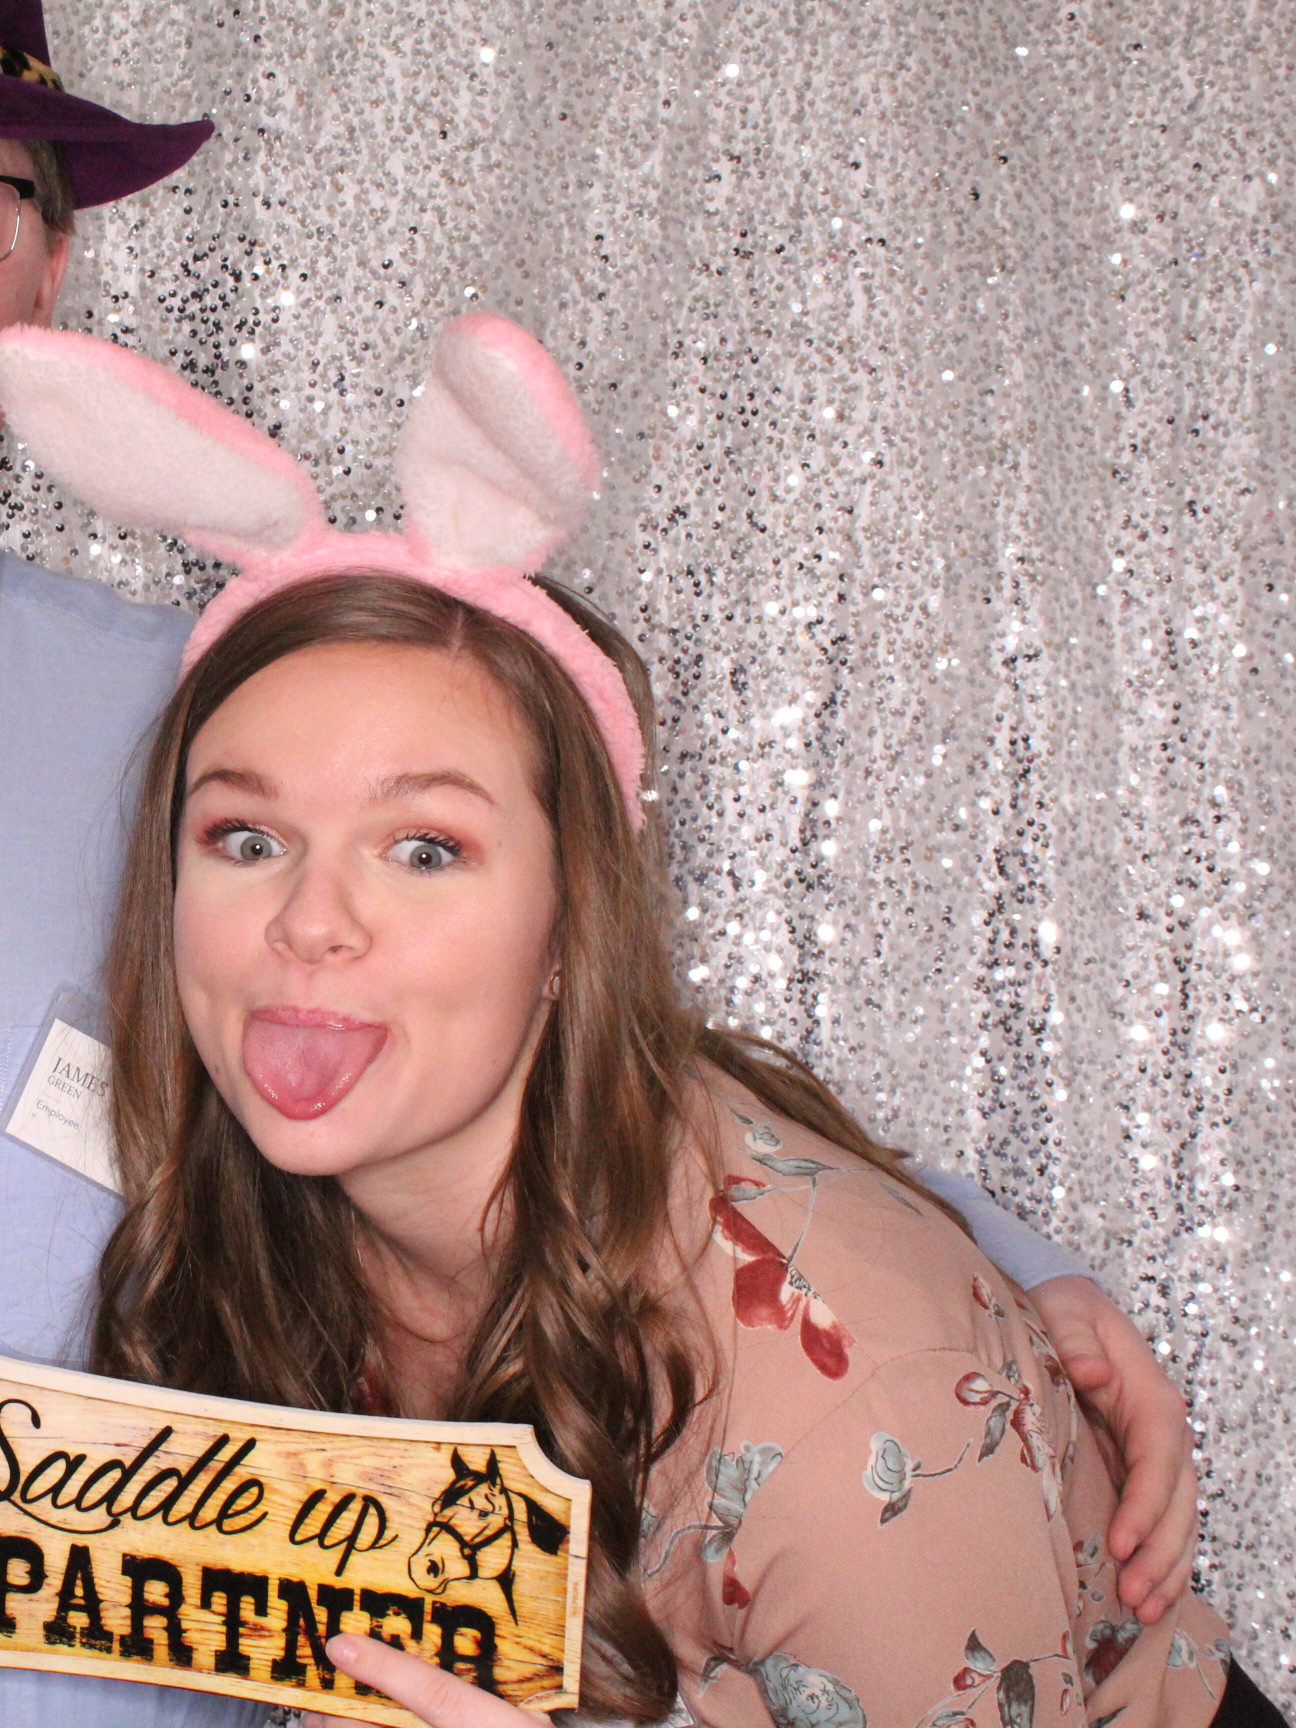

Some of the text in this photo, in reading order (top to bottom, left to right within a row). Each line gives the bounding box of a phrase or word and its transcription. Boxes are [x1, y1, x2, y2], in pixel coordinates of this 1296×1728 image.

[47, 1075, 83, 1100] GREEN
[52, 1057, 108, 1097] JAMES
[288, 1487, 399, 1577] up
